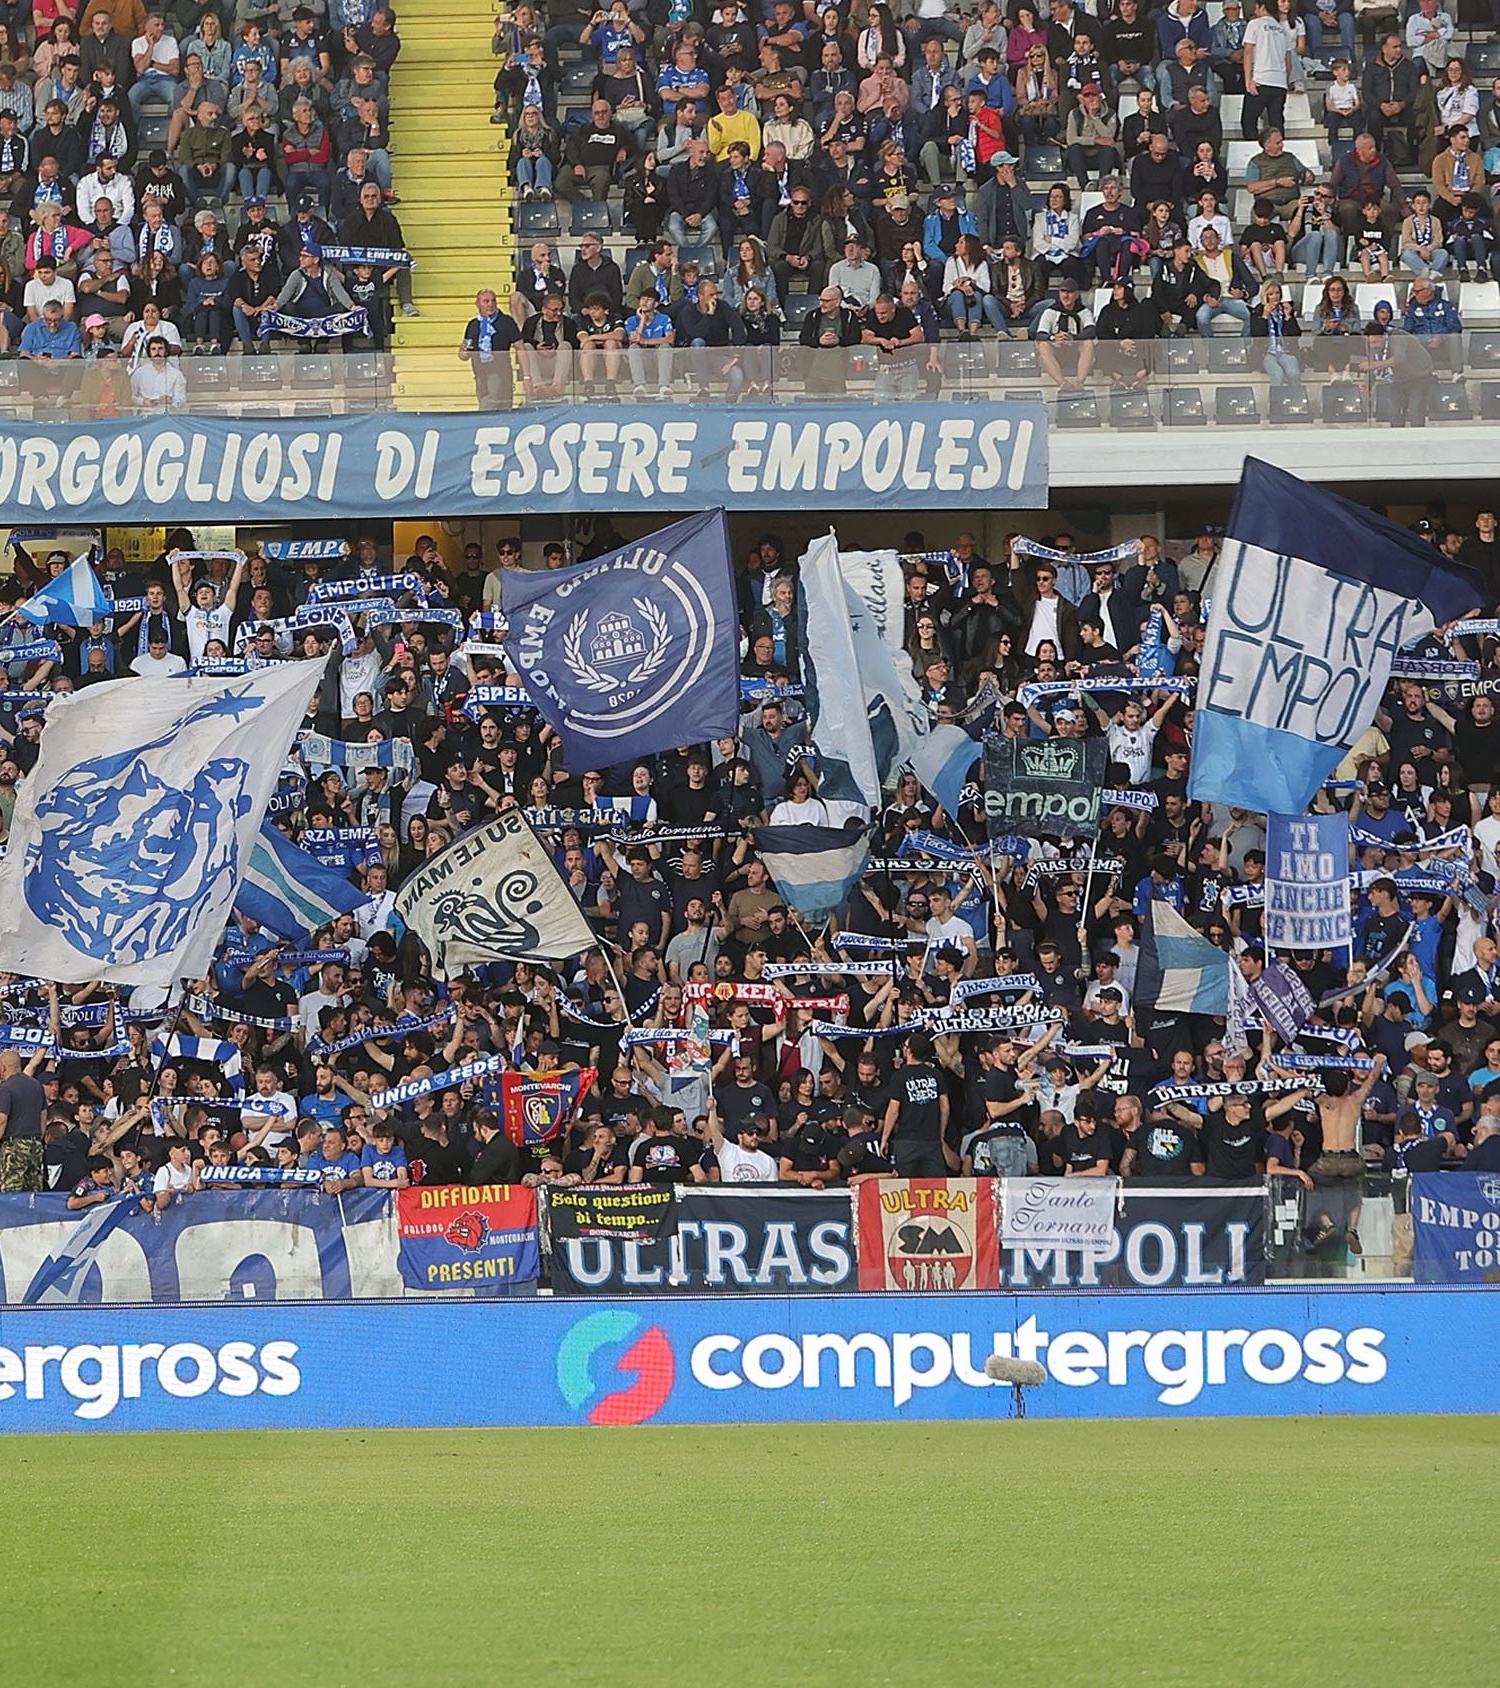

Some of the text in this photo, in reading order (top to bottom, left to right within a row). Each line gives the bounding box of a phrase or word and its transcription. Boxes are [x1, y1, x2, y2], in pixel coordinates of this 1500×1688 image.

[374, 429, 440, 499] DI
[471, 421, 698, 499] ESSERE
[727, 419, 1035, 494] EMPOLESI
[315, 576, 387, 600] EMPOLI
[113, 600, 141, 612] 1920
[985, 786, 1104, 823] empoli
[1288, 821, 1320, 852] TI
[1279, 851, 1336, 883] AMO
[1272, 884, 1343, 913] ANCHE
[1290, 911, 1349, 942] VINC
[371, 1054, 502, 1109] UNICA FEDE
[510, 1082, 572, 1095] MONTEVARCHI
[1155, 1082, 1232, 1105] ULTRAS
[201, 1165, 262, 1182] UNICA
[420, 1184, 511, 1209] DIFFIDATI
[551, 1191, 671, 1210] Solo questione
[403, 1222, 445, 1236] BULLDOG
[575, 1210, 592, 1225] di
[1010, 1207, 1109, 1235] Tornano
[563, 1218, 850, 1288] ULTRAS
[1010, 1222, 1252, 1286] MPOLI
[426, 1257, 515, 1283] PRESENTI
[691, 1314, 1388, 1407] computergross
